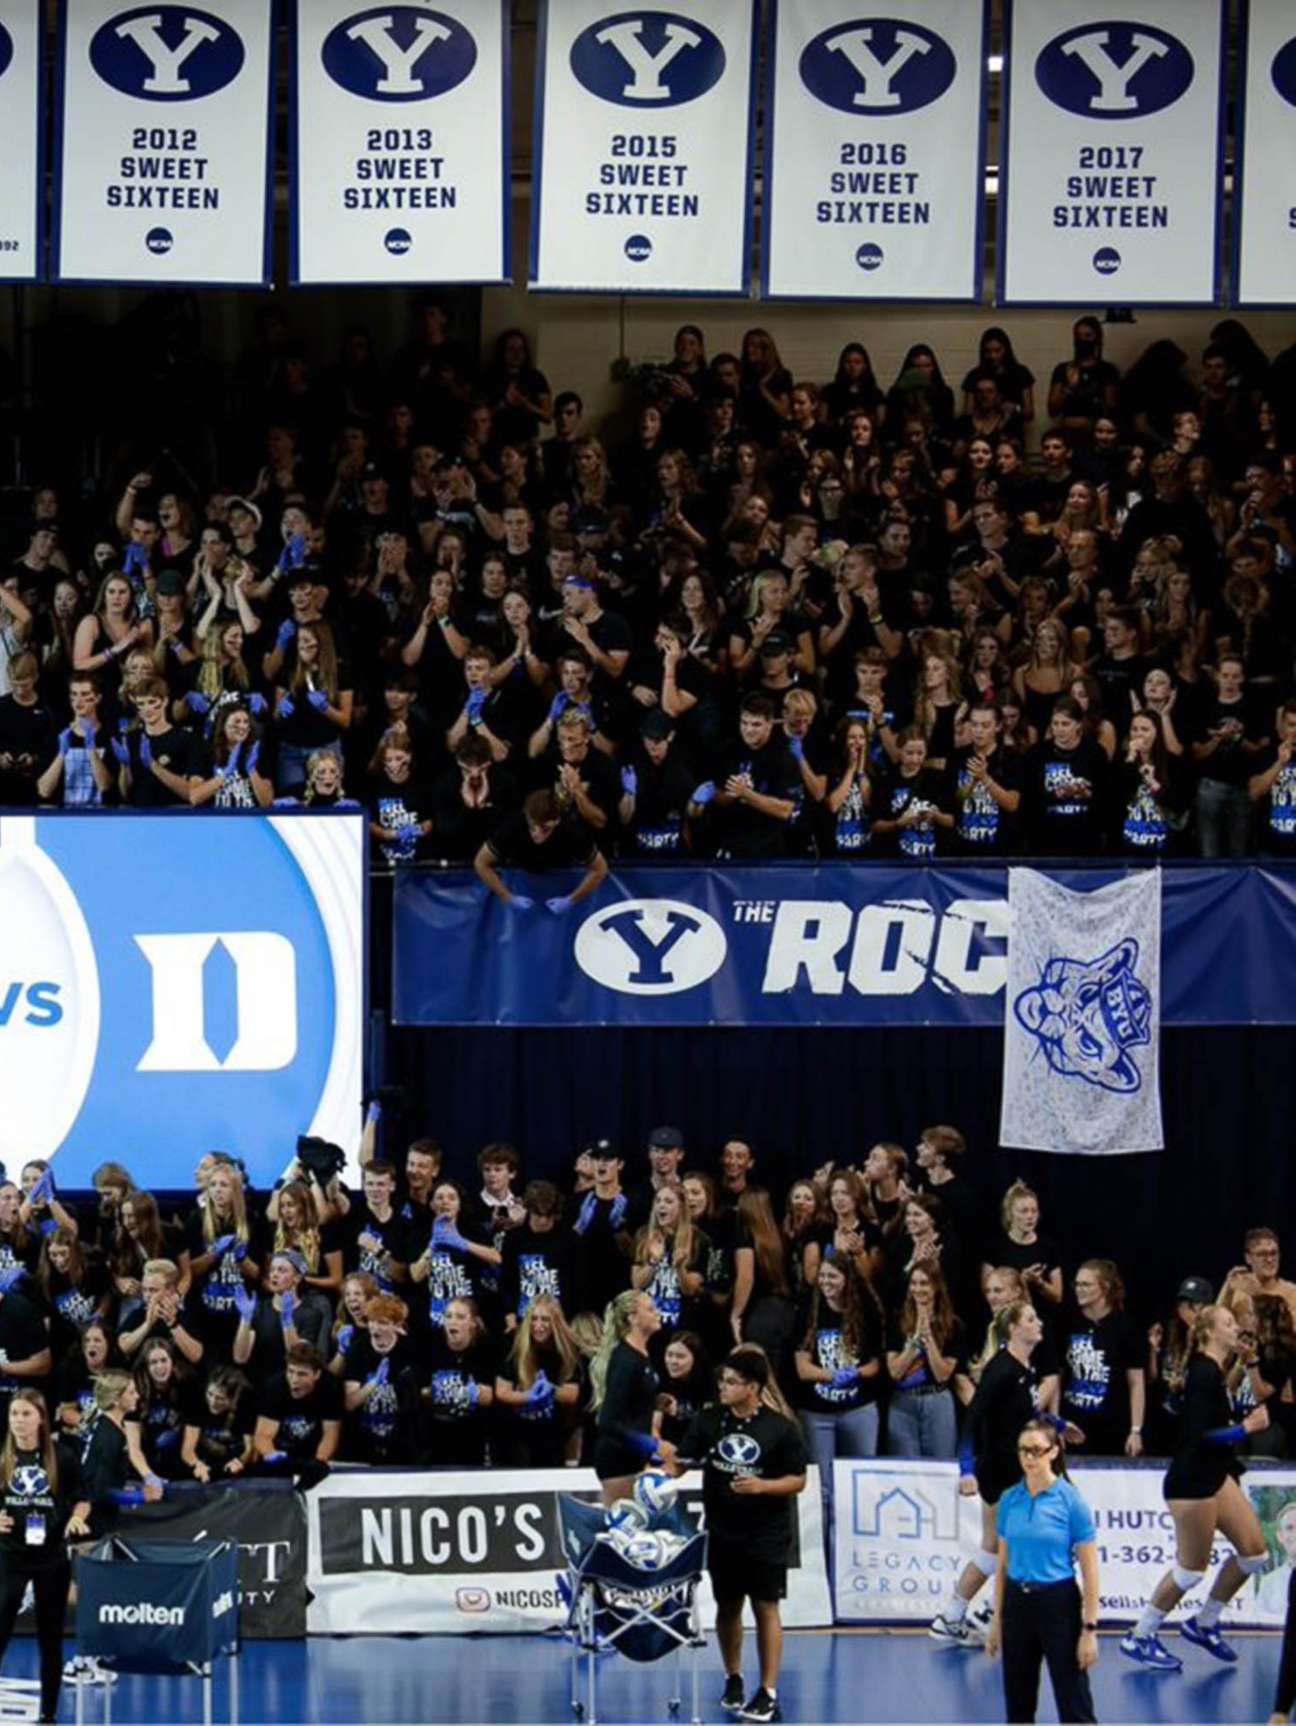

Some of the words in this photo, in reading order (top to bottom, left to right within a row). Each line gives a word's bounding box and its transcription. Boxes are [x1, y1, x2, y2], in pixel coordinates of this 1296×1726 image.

[133, 128, 196, 150] 2012
[368, 129, 431, 150] 2013
[612, 135, 676, 157] 2015
[841, 143, 906, 165] 2016
[1080, 147, 1143, 168] 2017
[121, 157, 208, 179] SWEET
[357, 158, 443, 180] SWEET
[601, 164, 687, 186] SWEET
[831, 172, 918, 194] SWEET
[1068, 177, 1156, 198] SWEET
[107, 186, 218, 209] SIXTEEN
[344, 187, 455, 209] SIXTEEN
[586, 193, 698, 216] SIXTEEN
[817, 202, 929, 223] SIXTEEN
[1054, 206, 1167, 227] SIXTEEN
[732, 900, 776, 924] THE
[761, 899, 1009, 995] ROC
[133, 931, 298, 1072] D
[361, 1503, 545, 1565] NICO'S
[852, 1551, 962, 1572] LEGACY
[852, 1575, 958, 1595] GROU
[98, 1602, 186, 1626] molten
